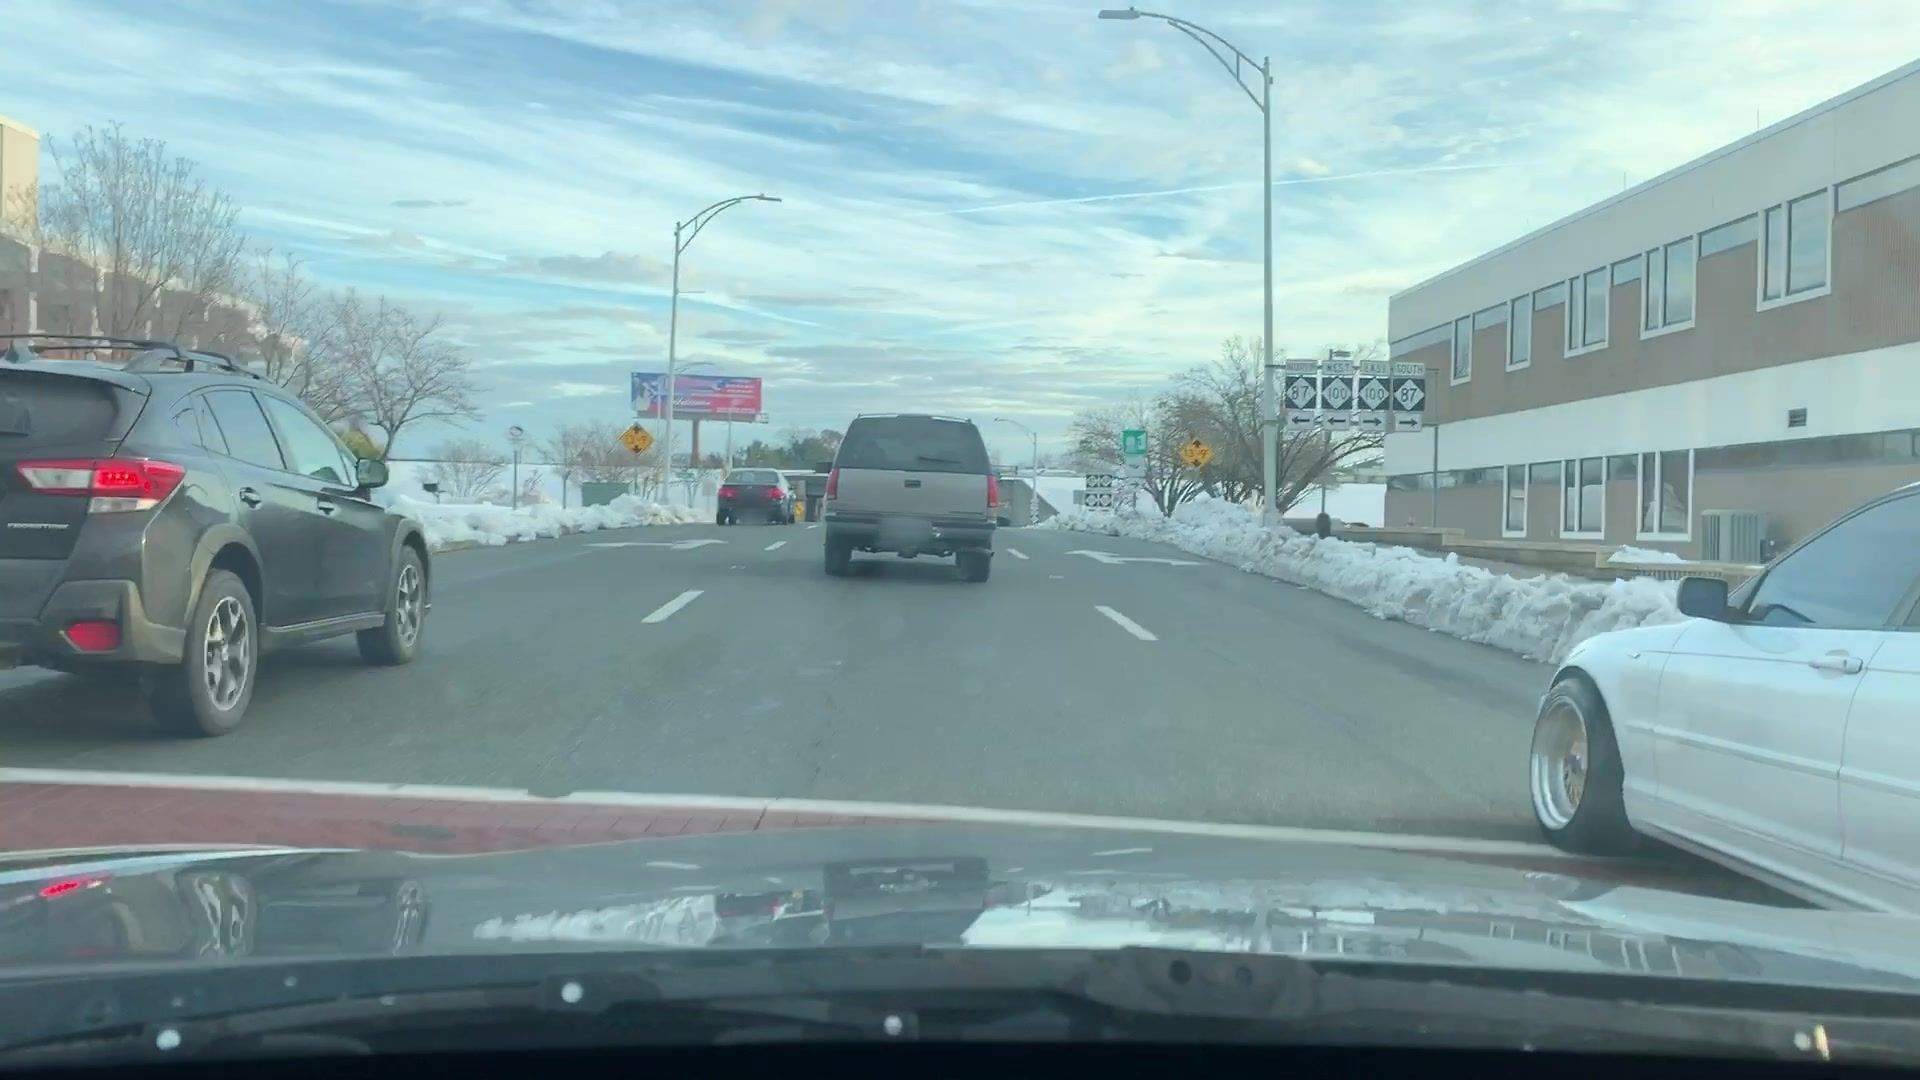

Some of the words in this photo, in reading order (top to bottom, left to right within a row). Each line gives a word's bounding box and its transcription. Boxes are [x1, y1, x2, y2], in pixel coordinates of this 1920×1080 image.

[1396, 364, 1423, 375] SOUTH
[1291, 386, 1309, 400] 87
[1328, 388, 1347, 400] 100
[1365, 388, 1385, 400] 100
[1401, 388, 1417, 402] 87
